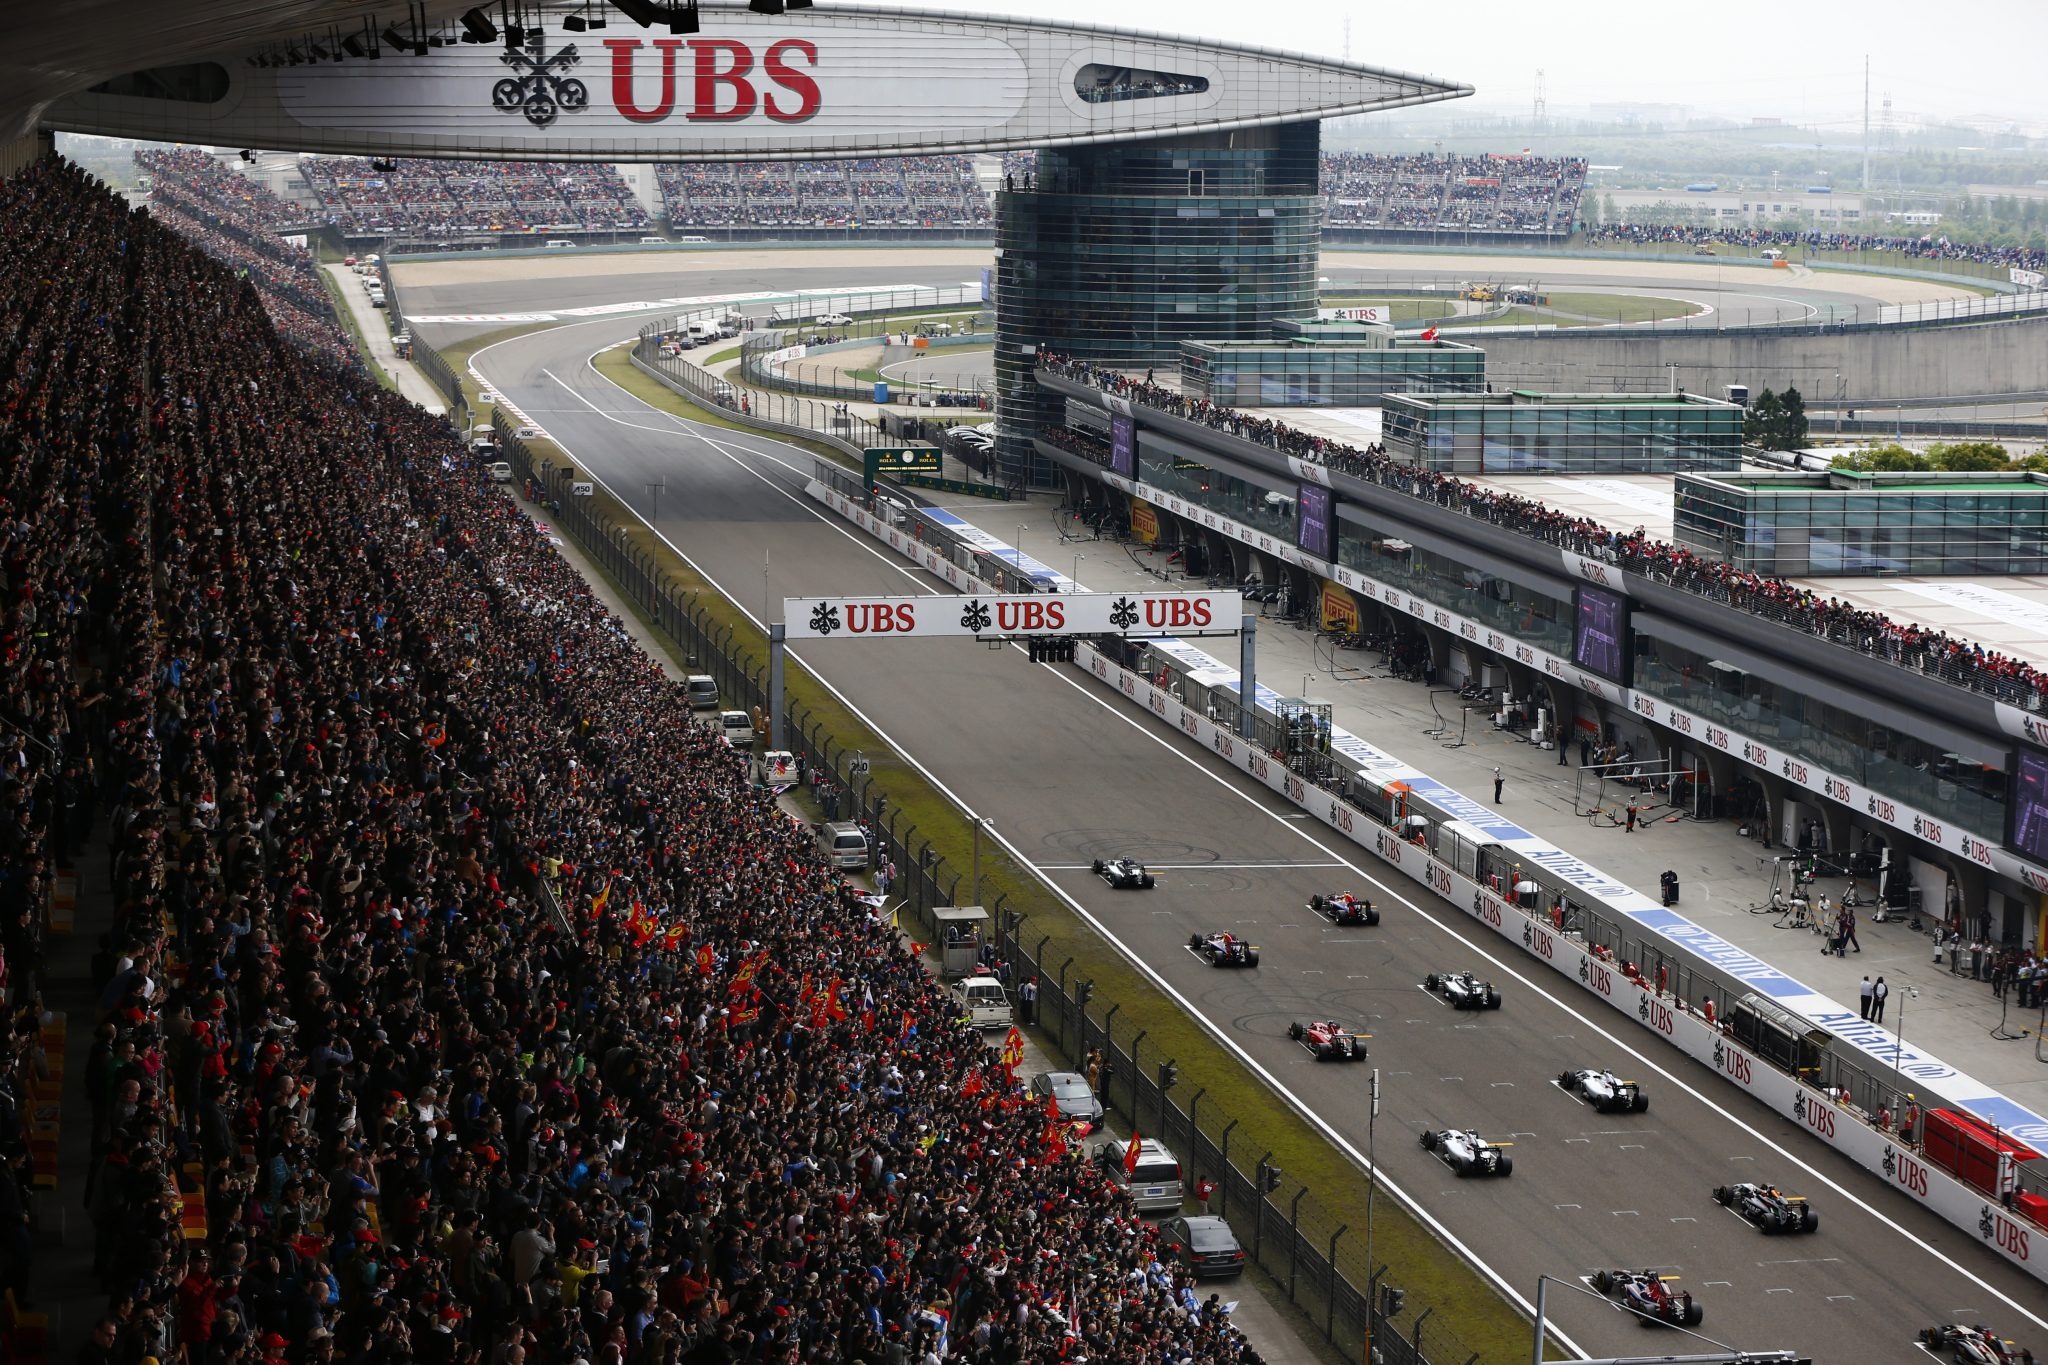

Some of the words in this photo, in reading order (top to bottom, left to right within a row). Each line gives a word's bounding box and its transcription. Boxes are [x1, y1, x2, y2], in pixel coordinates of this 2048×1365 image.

[603, 39, 822, 124] UBS
[1348, 308, 1377, 320] UBS
[1133, 507, 1155, 534] PIRELLI
[1587, 563, 1610, 586] UBS
[845, 602, 915, 633] UBS
[996, 600, 1065, 631] UBS
[1143, 598, 1212, 627] UBS
[1343, 571, 1351, 586] UBS
[1366, 581, 1376, 597] UBS
[1390, 591, 1400, 607] UBS
[1414, 602, 1424, 617] UBS
[1439, 612, 1450, 629] UBS
[1465, 622, 1477, 640] UBS
[1493, 633, 1505, 652] UBS
[1521, 645, 1533, 665] UBS
[851, 762, 867, 771] 20
[1641, 697, 1655, 717] UBS
[1677, 713, 1691, 733] UBS
[1713, 729, 1728, 750] UBS
[1751, 745, 1767, 766] UBS
[1791, 762, 1808, 785] UBS
[1833, 780, 1850, 803] UBS
[1877, 799, 1895, 823] UBS
[1923, 819, 1942, 843] UBS
[1971, 840, 1991, 866] UBS
[1525, 851, 1602, 886] Allianz
[1097, 657, 1107, 679] UBS
[1124, 674, 1135, 696] UBS
[1154, 693, 1166, 716] UBS
[1185, 713, 1198, 736] UBS
[1220, 735, 1233, 758] UBS
[1254, 756, 1268, 780] UBS
[1290, 778, 1305, 803] UBS
[1337, 806, 1353, 833] UBS
[1385, 835, 1401, 863] UBS
[1434, 865, 1451, 895] UBS
[1483, 894, 1502, 927] UBS
[1533, 927, 1553, 960] UBS
[1589, 960, 1611, 996] UBS
[1650, 998, 1673, 1035] UBS
[1726, 1046, 1751, 1085] UBS
[1807, 1098, 1836, 1139] UBS
[1897, 1153, 1928, 1197] UBS
[1996, 1214, 2029, 1261] UBS
[1689, 936, 1784, 979] Allianz
[1807, 1012, 1919, 1062] Allianz
